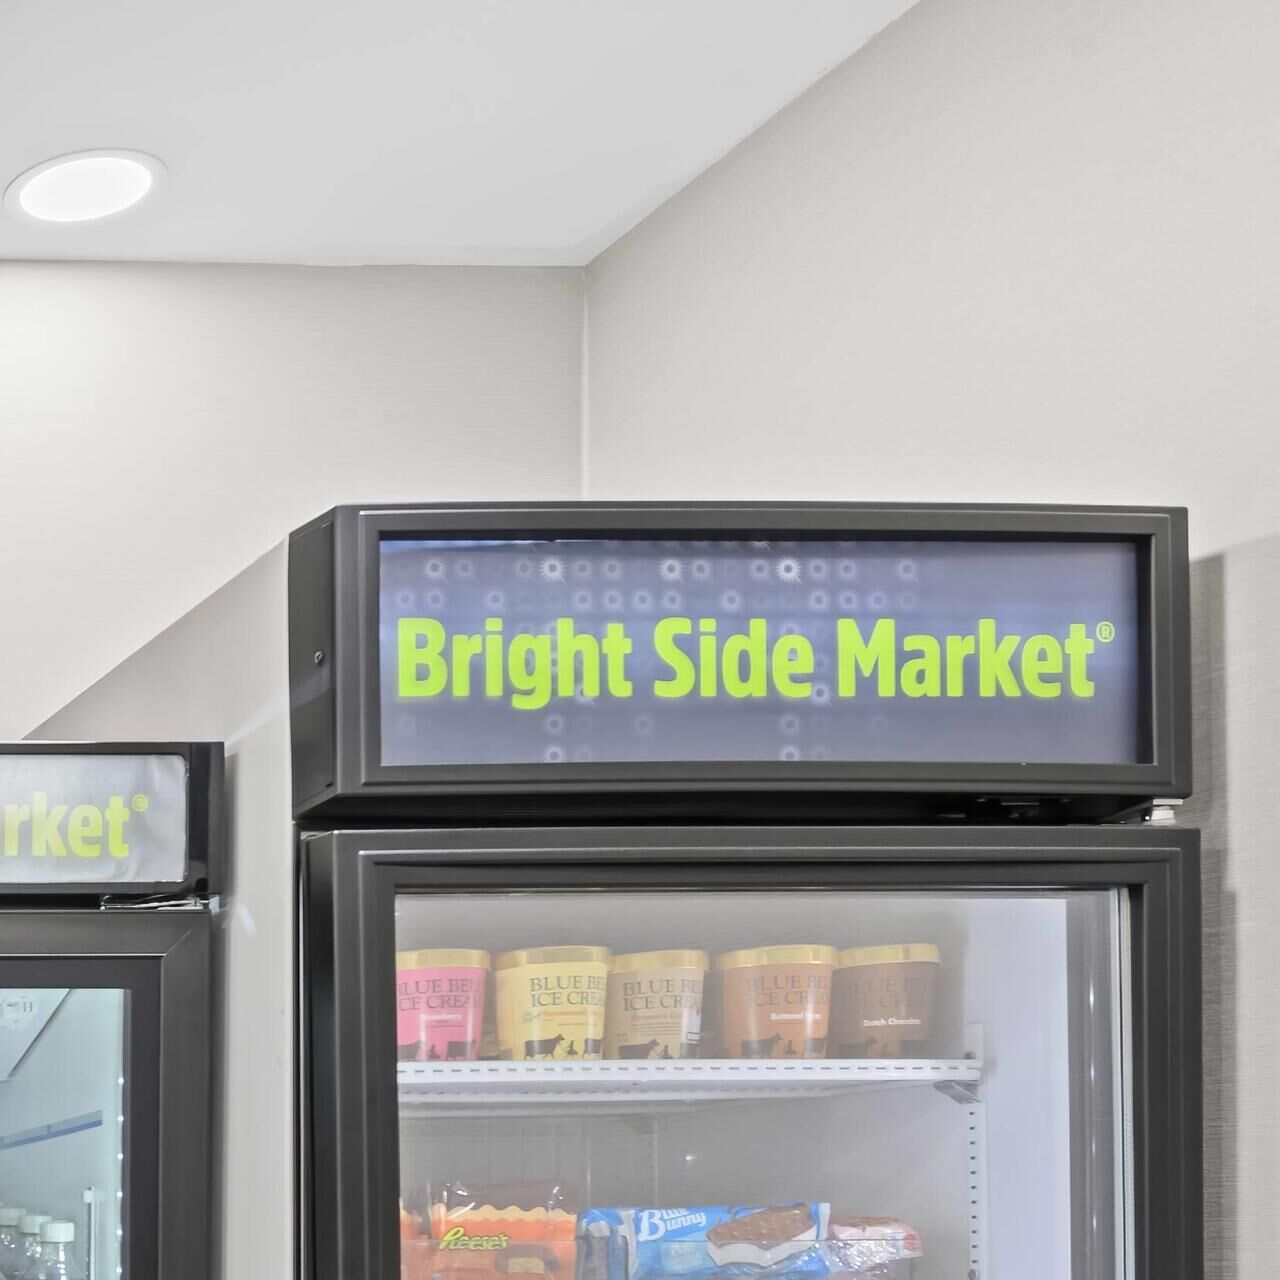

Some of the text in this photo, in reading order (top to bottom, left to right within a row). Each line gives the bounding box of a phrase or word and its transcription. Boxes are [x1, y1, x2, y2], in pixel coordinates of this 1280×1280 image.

[397, 617, 633, 710] Bright
[654, 617, 812, 698] Side
[529, 975, 583, 993] BLUE
[623, 979, 674, 996] BLUE
[531, 992, 563, 1008] ICE
[623, 996, 654, 1012] ICE
[439, 1226, 512, 1251] Reese's
